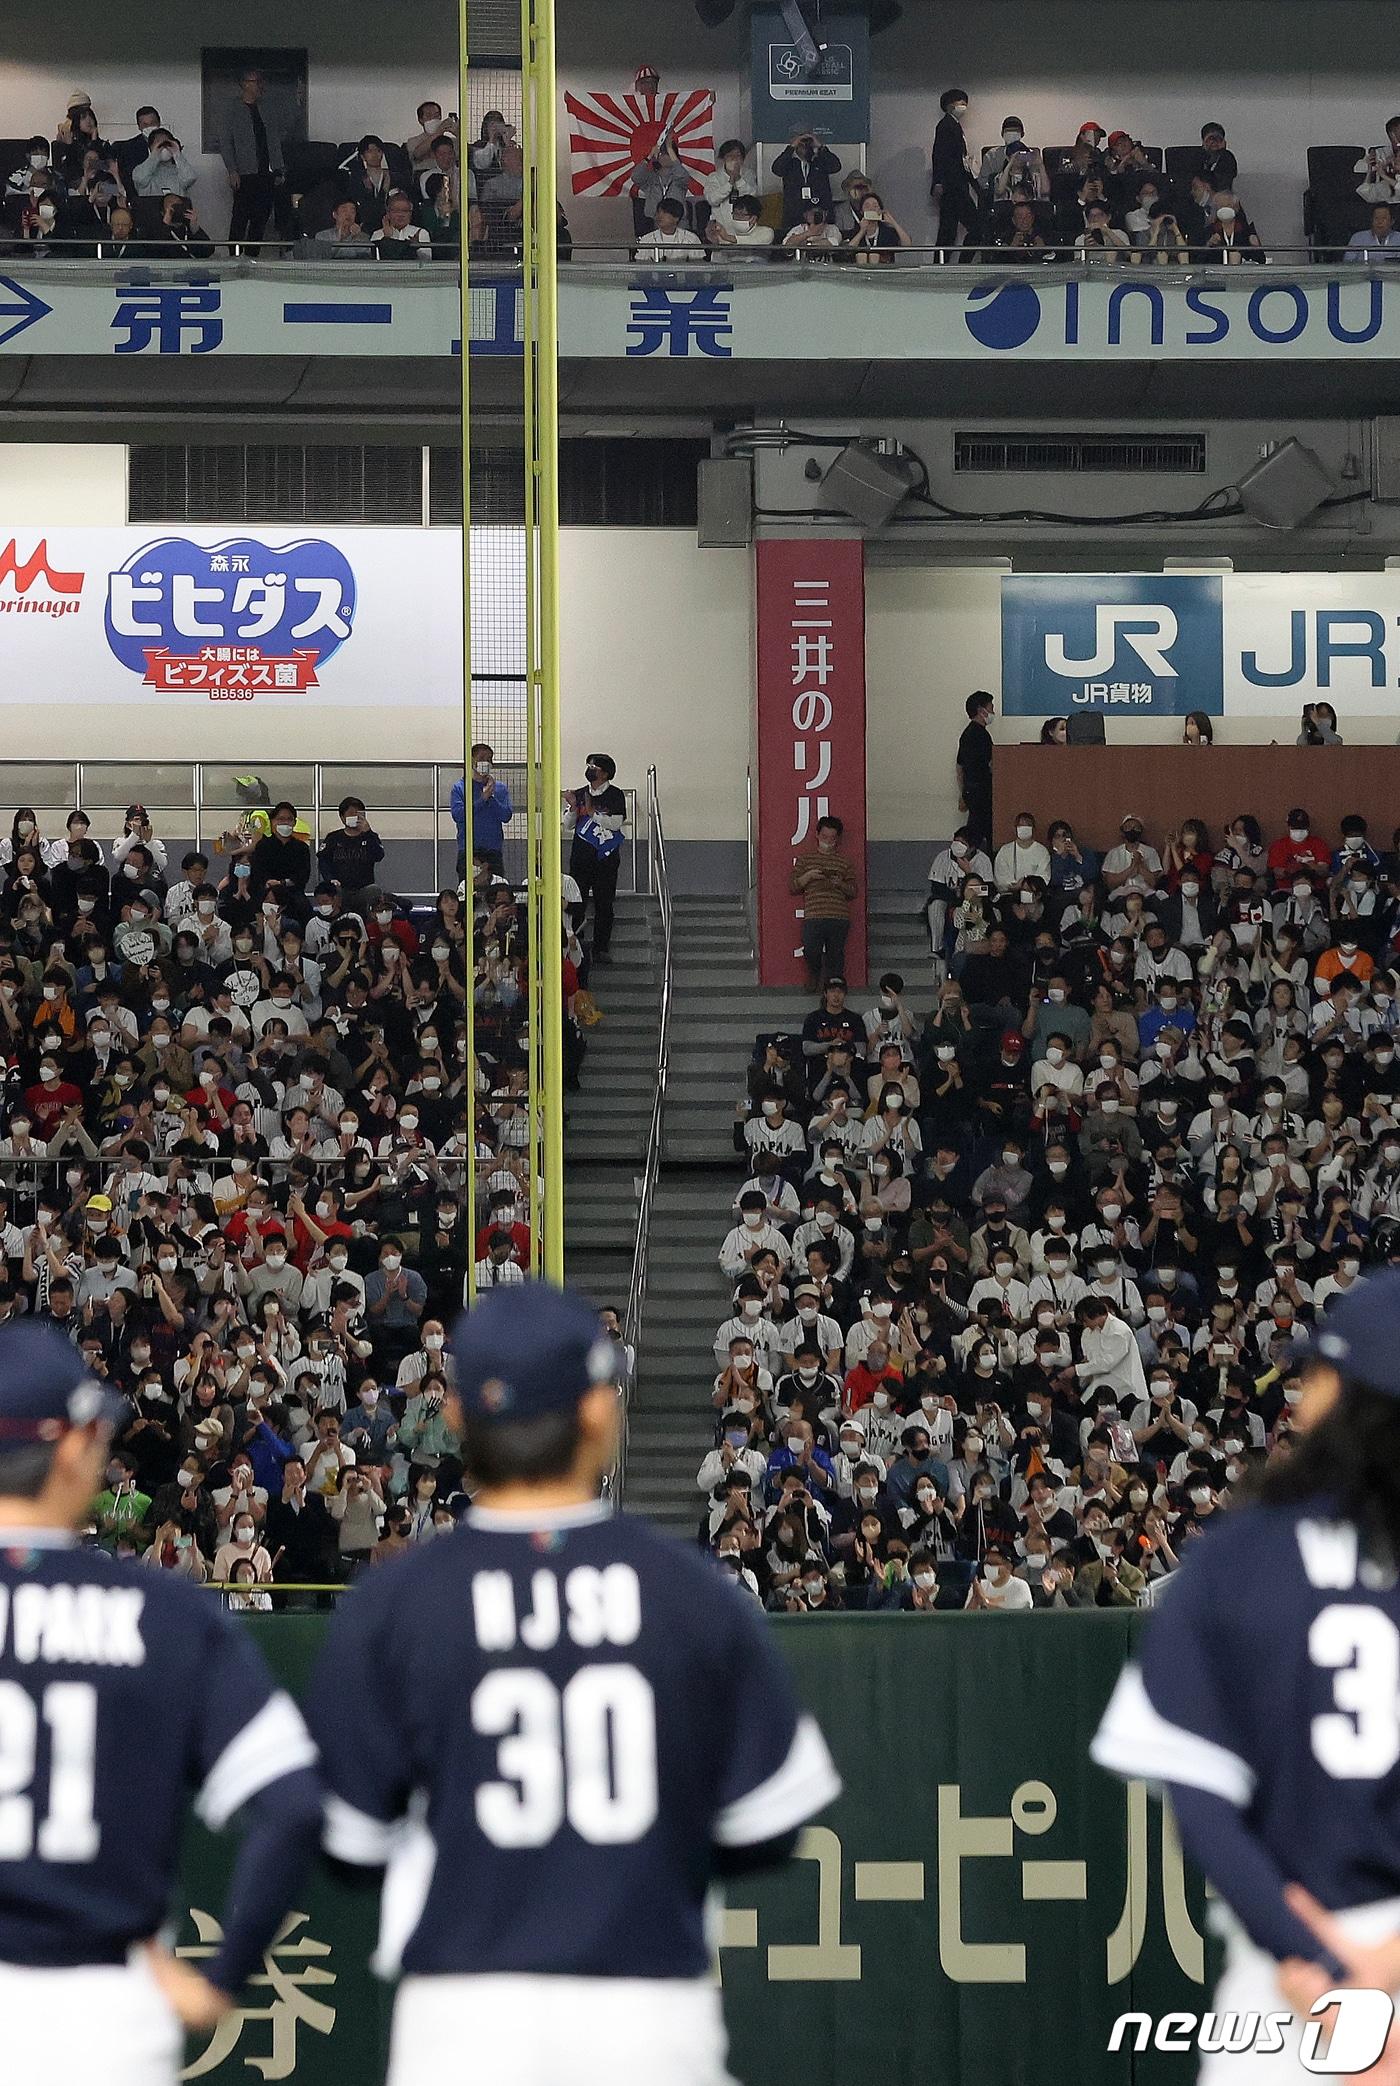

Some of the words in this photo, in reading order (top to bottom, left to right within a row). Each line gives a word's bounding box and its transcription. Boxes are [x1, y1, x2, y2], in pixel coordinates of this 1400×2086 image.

[209, 555, 250, 572] 森永
[109, 572, 352, 639] ビヒダス
[1044, 604, 1180, 677] JR
[201, 647, 260, 662] 大腸には
[164, 663, 298, 687] ビフィズス菌
[210, 689, 253, 701] BB536
[1071, 682, 1153, 704] JR貨物
[471, 1663, 657, 1849] 30
